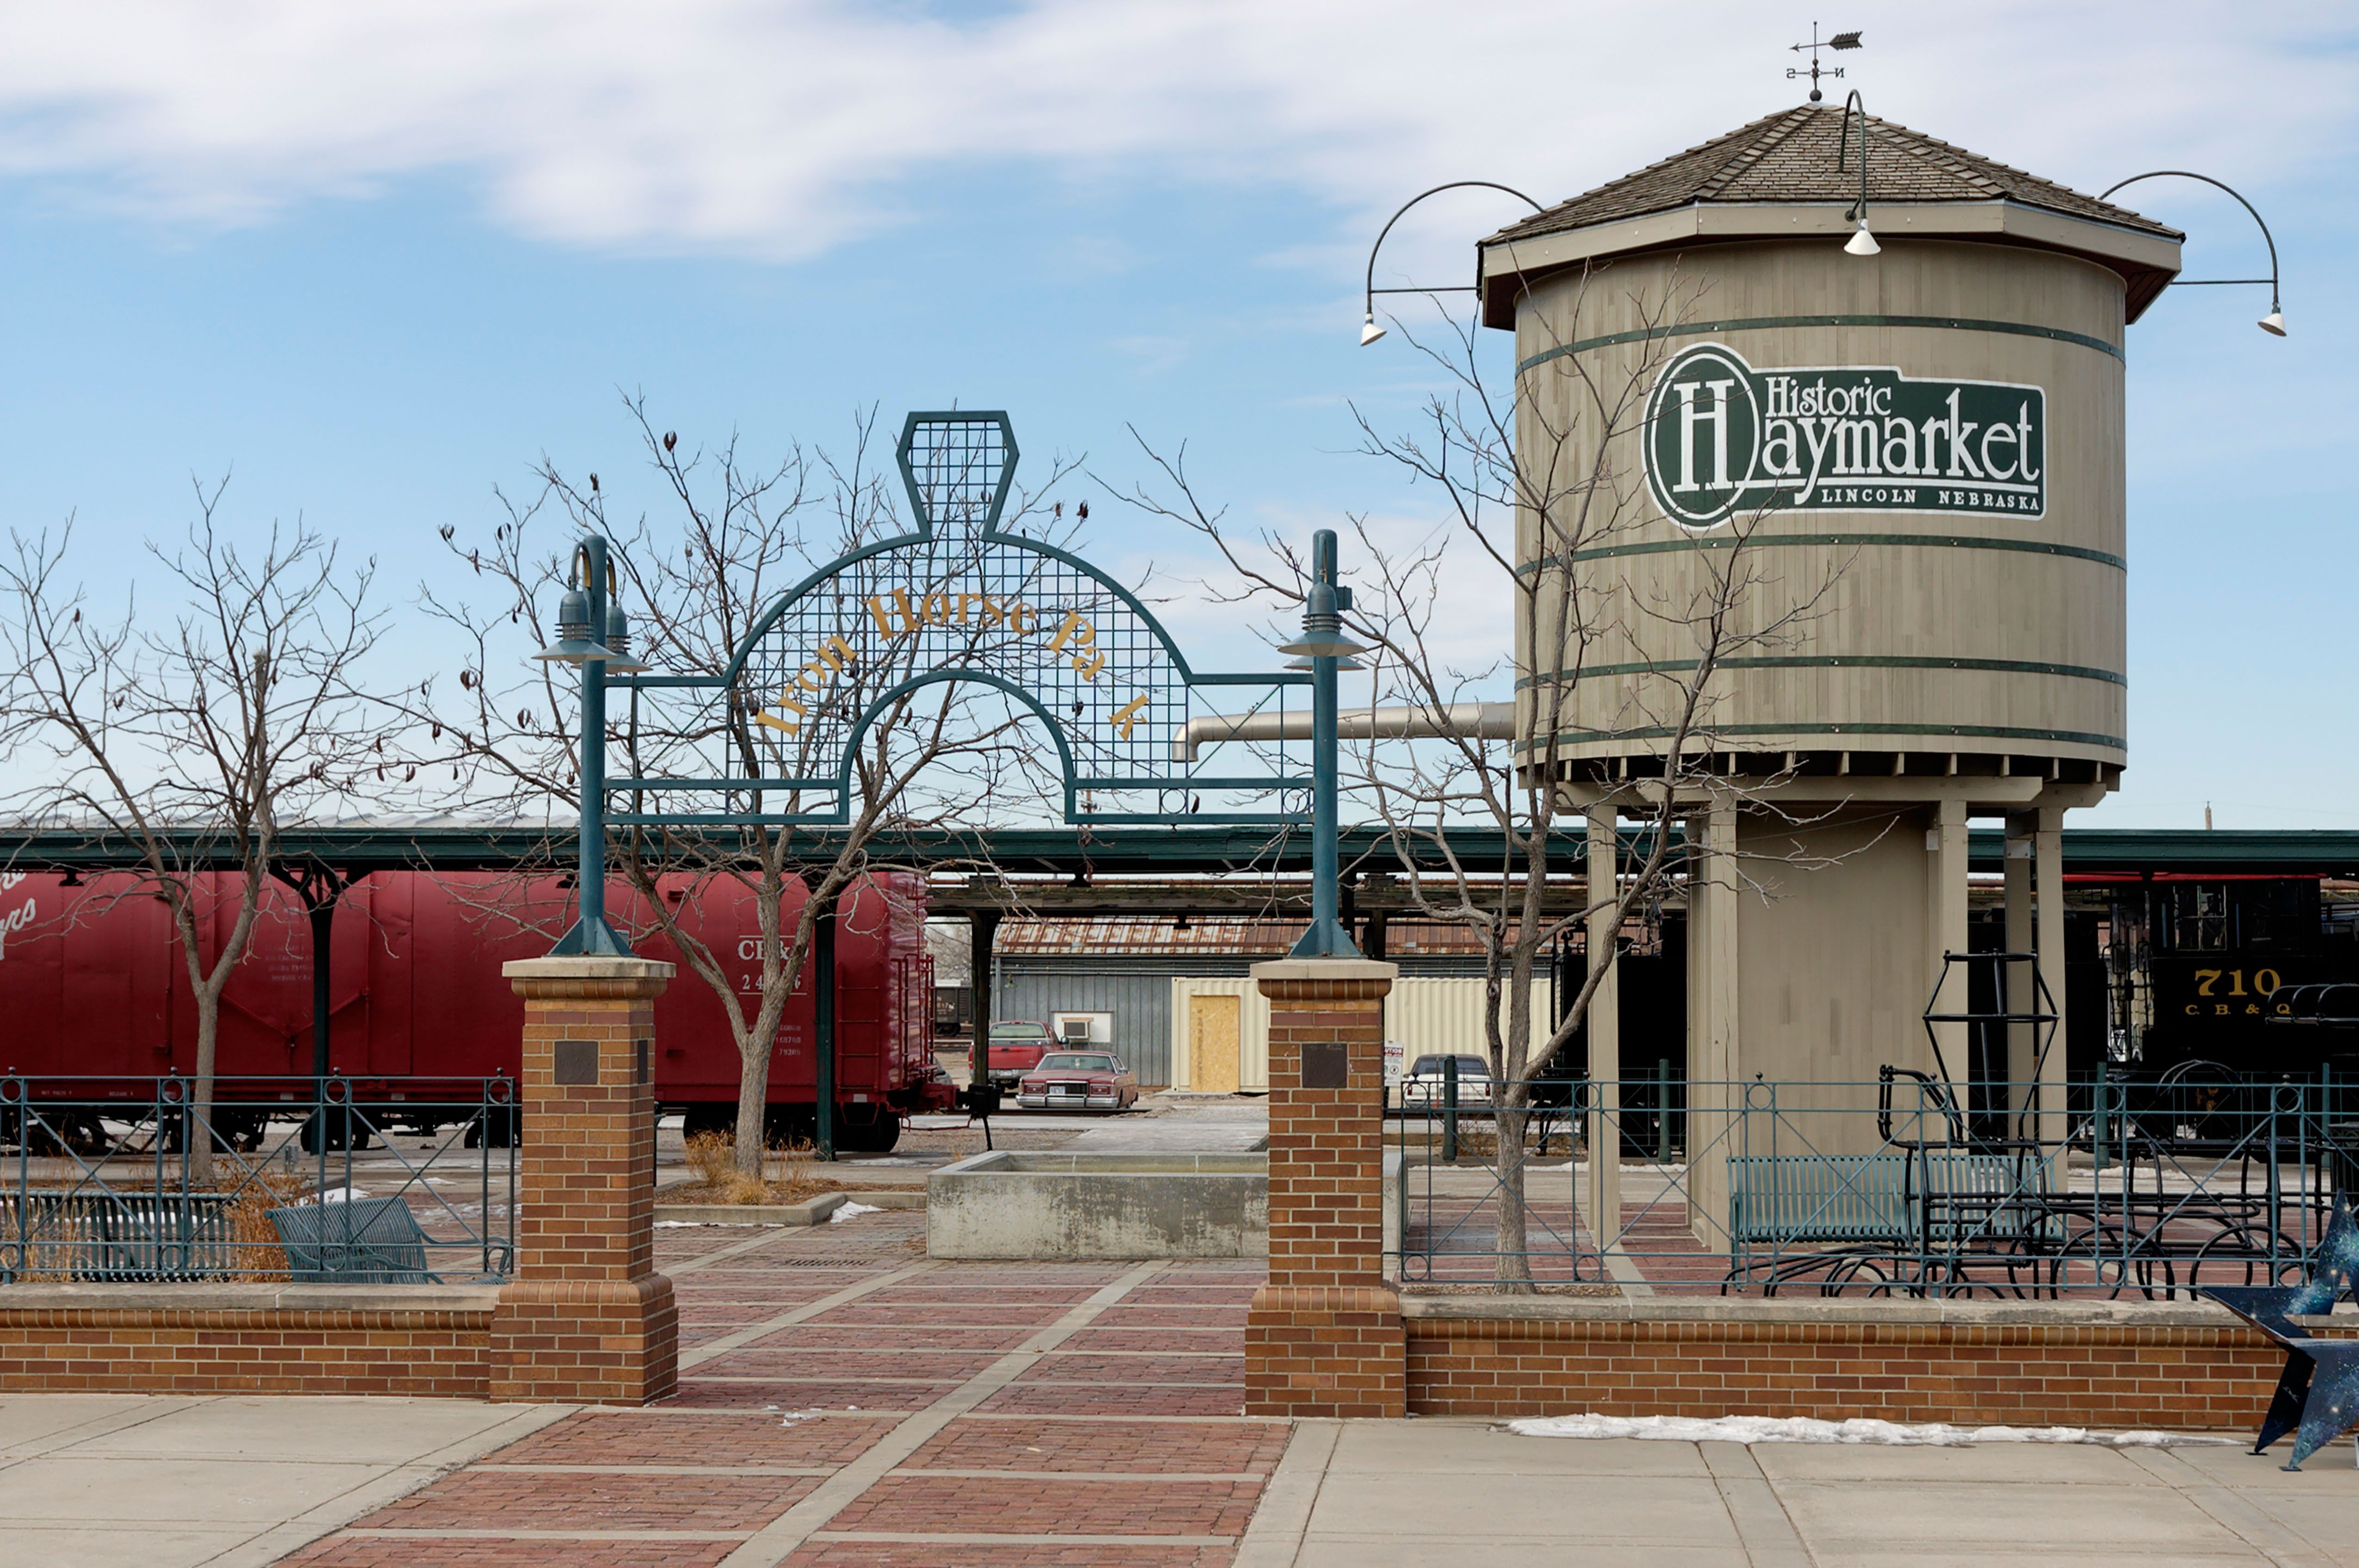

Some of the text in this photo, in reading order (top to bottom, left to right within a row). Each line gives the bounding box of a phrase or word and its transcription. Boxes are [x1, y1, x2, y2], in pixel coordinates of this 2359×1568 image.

[1765, 376, 1891, 417] Historic
[1673, 378, 2040, 505] Haymarket
[1821, 488, 2039, 511] LINCOLN NEBRASKA
[755, 635, 858, 741] Iron
[865, 585, 1037, 642] Horse
[742, 974, 801, 990] 246
[2195, 968, 2281, 996] 710
[2185, 1004, 2200, 1015] C.
[2215, 1004, 2231, 1015] B.
[2245, 1004, 2260, 1014] &
